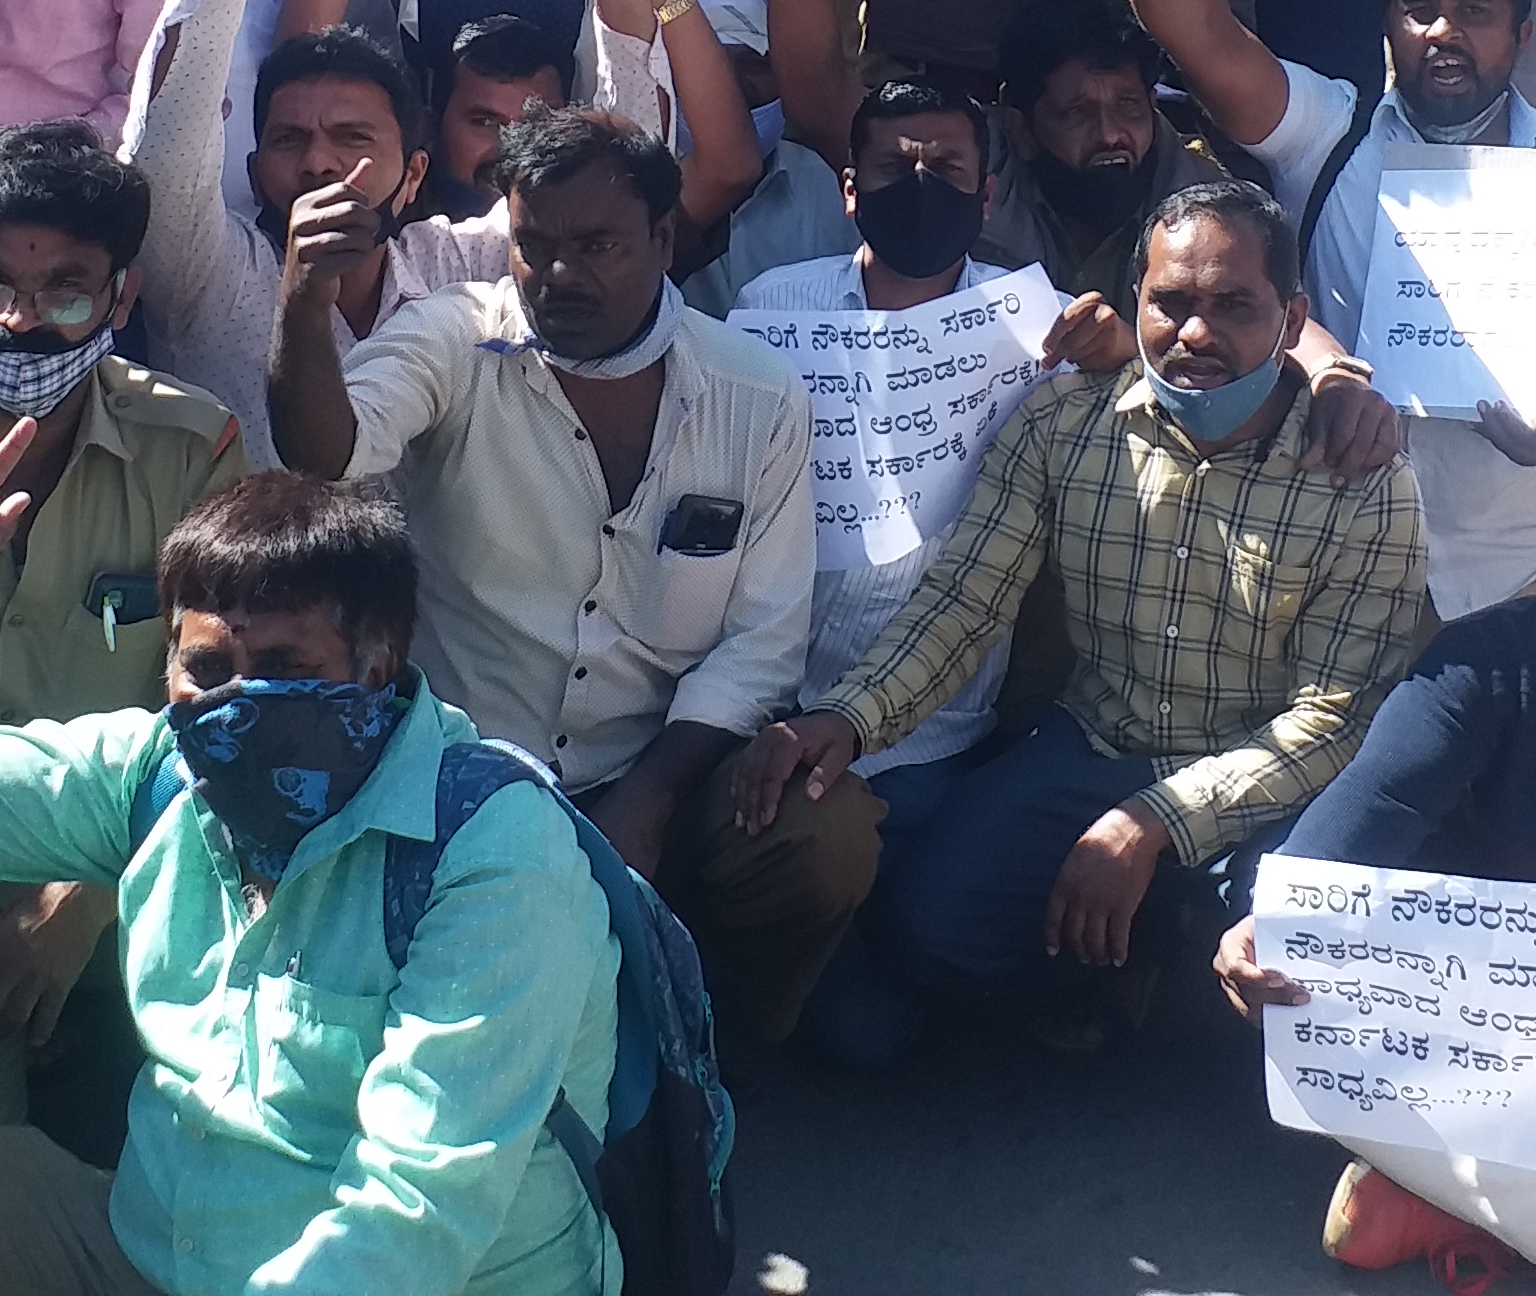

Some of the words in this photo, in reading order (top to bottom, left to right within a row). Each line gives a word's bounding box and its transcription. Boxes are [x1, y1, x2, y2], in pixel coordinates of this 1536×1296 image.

[812, 323, 933, 354] ನೌಕರರನ್ನು
[940, 292, 1021, 337] ಸರ್ಕಾರಿ
[886, 352, 987, 392] ಮಾಡಲು
[871, 402, 938, 437] ಆಂಧ್ರ
[865, 432, 967, 480] ಸರ್ಕಾರಕ್ಕೆ
[1285, 882, 1372, 918] ಸಾರಿಗೆ
[1285, 931, 1468, 990] ನೌಕರರನ್ನಾಗಿ
[1294, 1016, 1430, 1062] ಕರ್ನಾಟಕ
